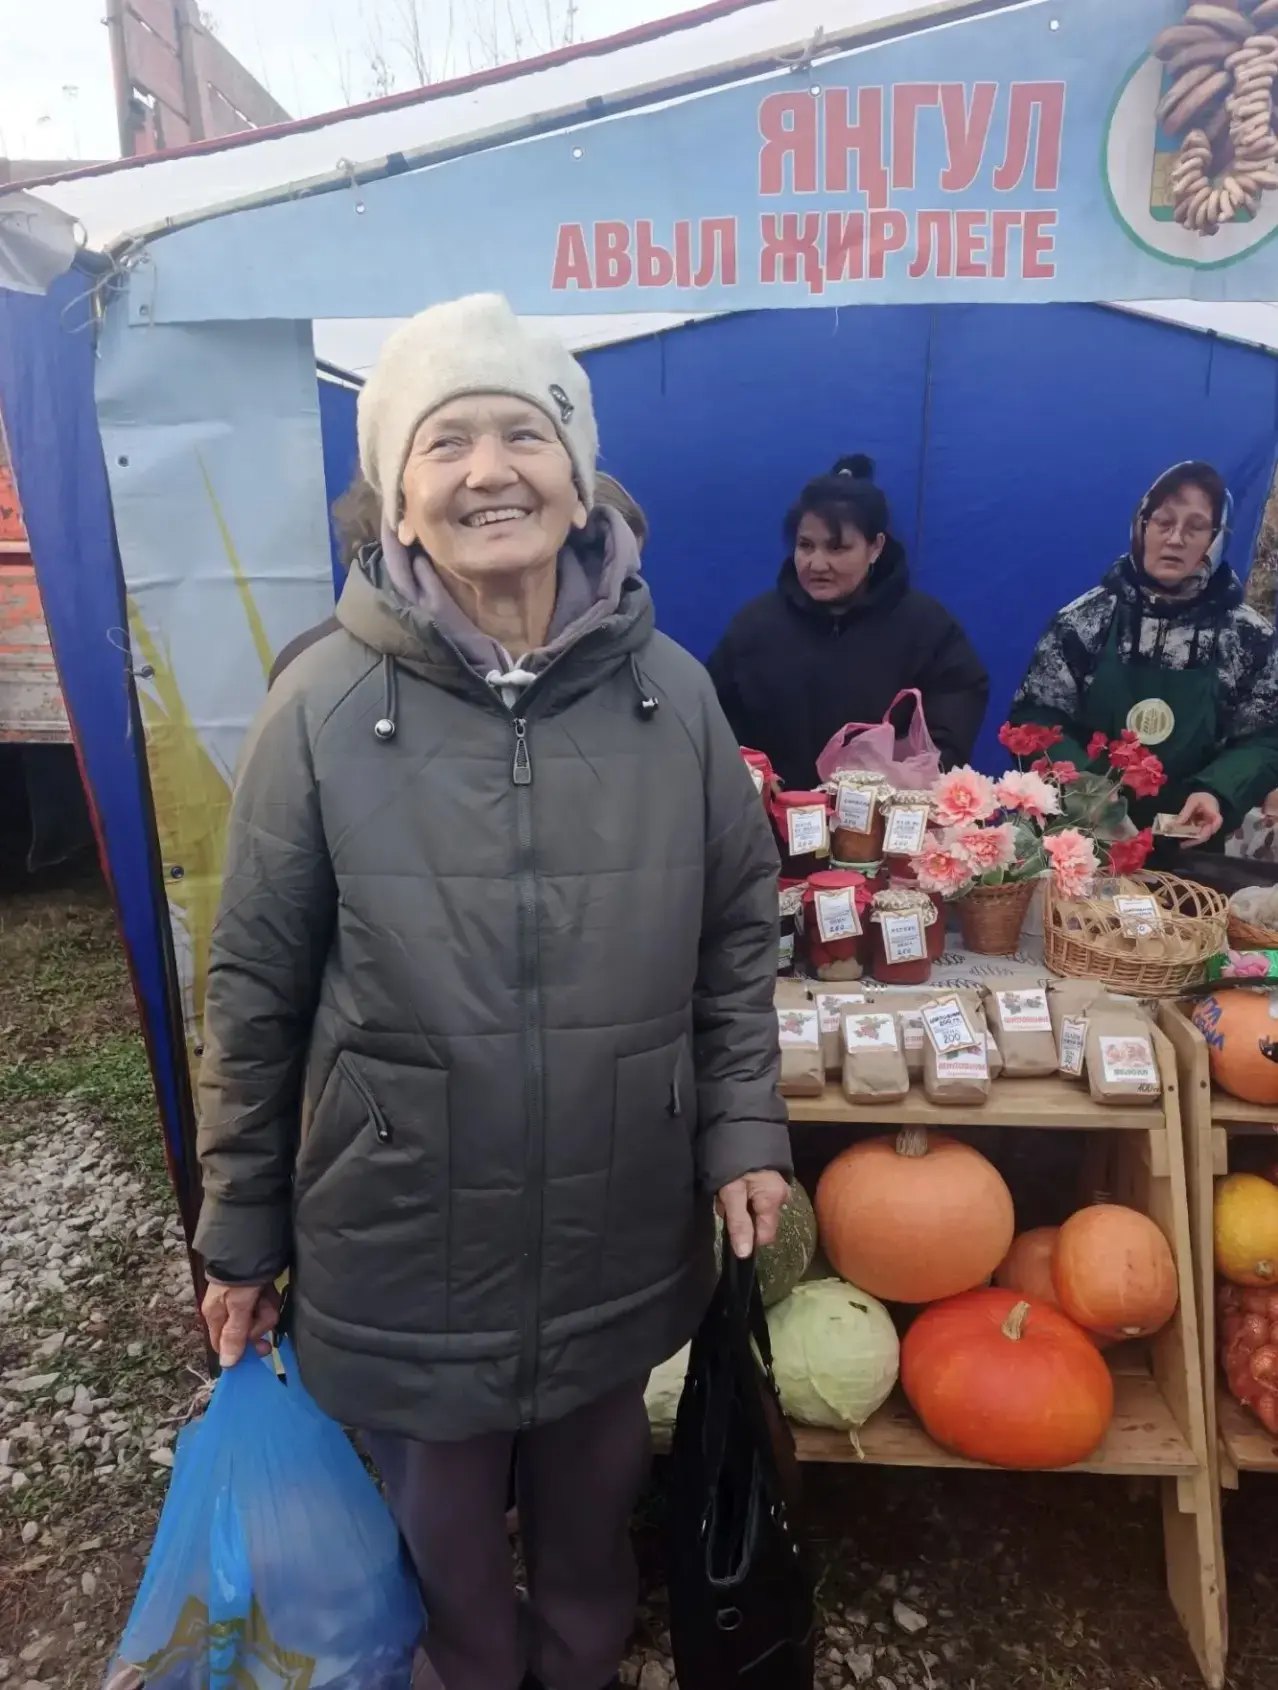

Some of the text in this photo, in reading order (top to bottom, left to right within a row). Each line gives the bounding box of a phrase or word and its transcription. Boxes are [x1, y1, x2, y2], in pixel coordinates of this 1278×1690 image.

[759, 80, 1066, 209] ЯҢГУЛ
[551, 209, 1058, 296] АВЫЛ ҖИРЛЕГЕ
[943, 1033, 961, 1044] 200
